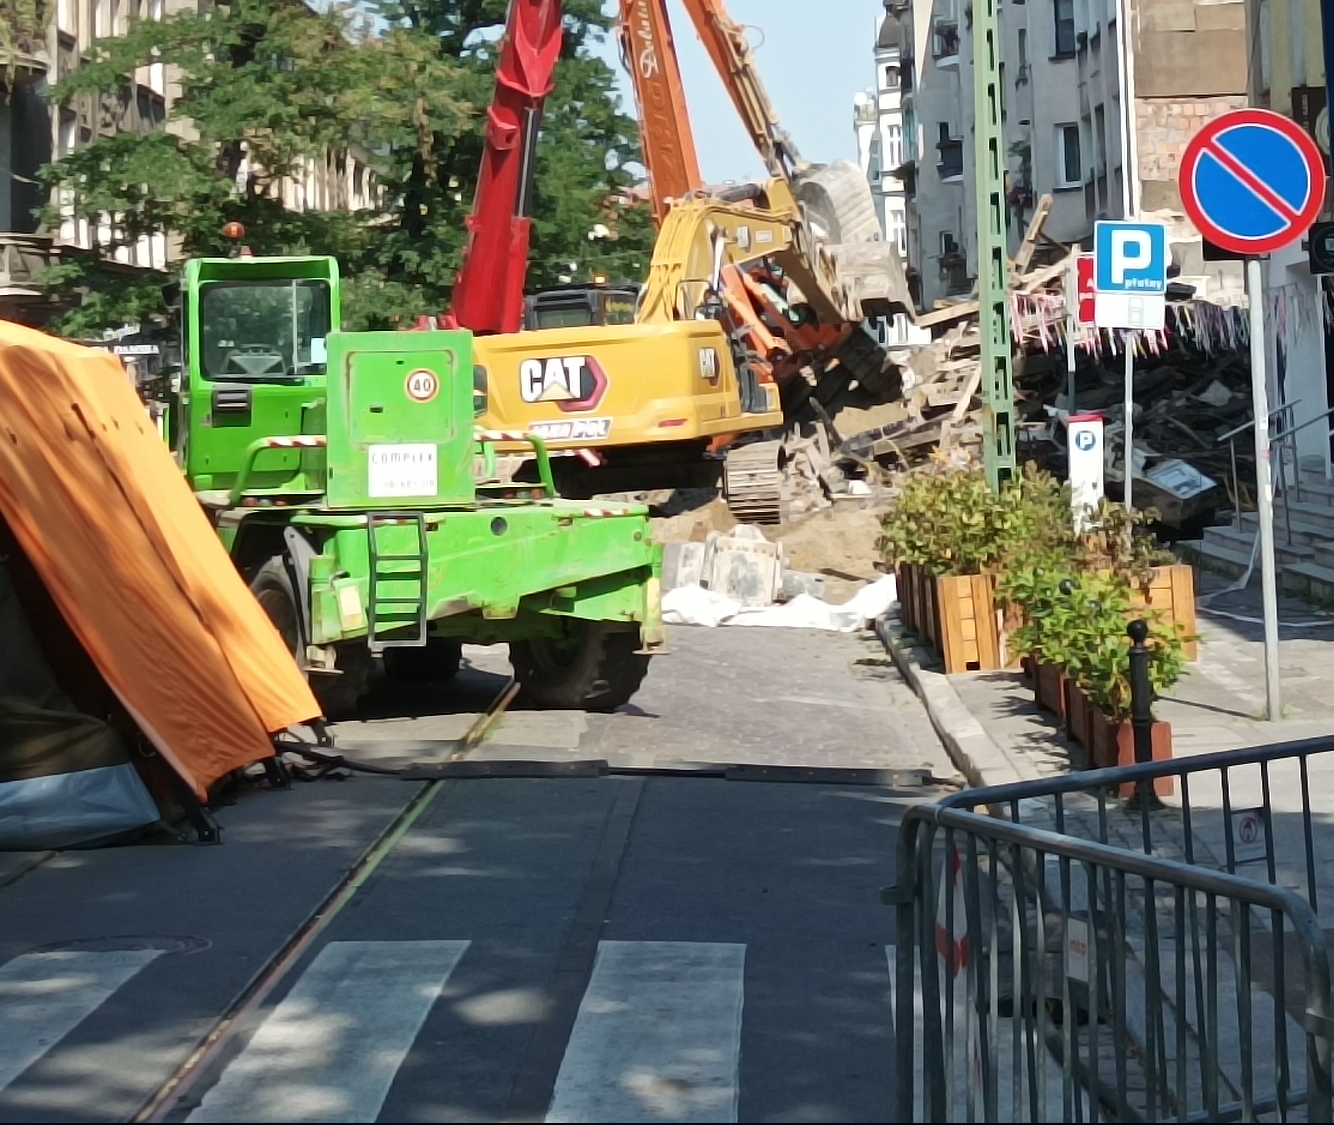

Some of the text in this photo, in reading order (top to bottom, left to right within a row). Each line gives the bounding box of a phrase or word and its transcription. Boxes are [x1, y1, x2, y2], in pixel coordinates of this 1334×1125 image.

[1111, 230, 1152, 284] P
[413, 378, 431, 392] 40
[521, 356, 585, 402] CAT
[1080, 433, 1093, 449] P
